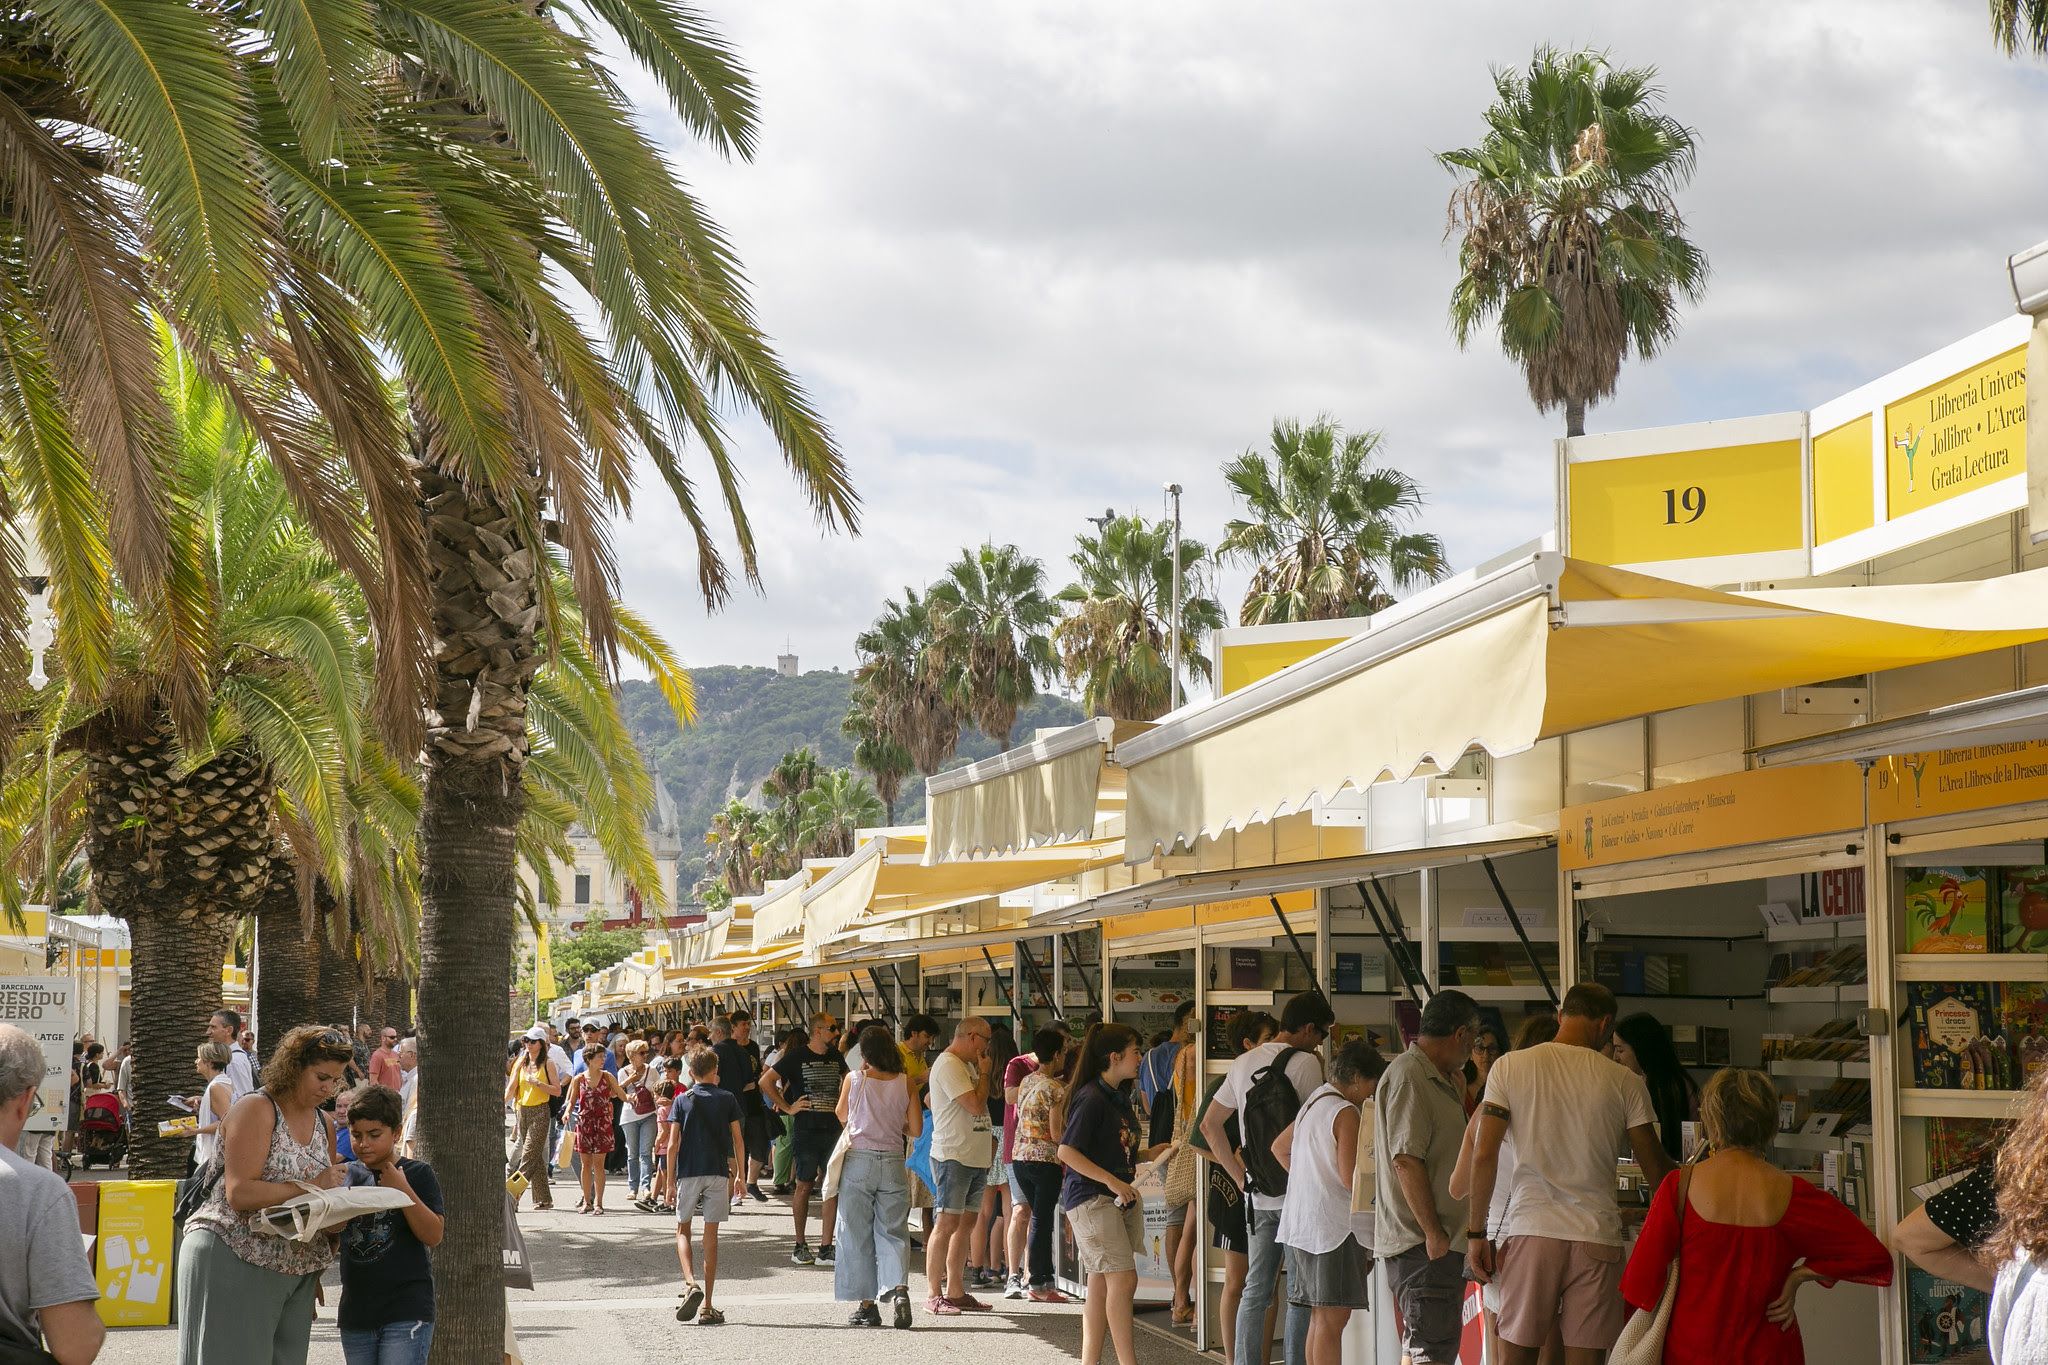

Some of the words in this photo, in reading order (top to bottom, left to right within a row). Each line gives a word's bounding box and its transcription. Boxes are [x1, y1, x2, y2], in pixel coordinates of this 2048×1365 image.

[1930, 384, 1978, 422] Llibreria
[1980, 367, 2026, 401] Univers
[1931, 424, 1972, 458] Jollibre
[1986, 404, 2026, 435] L'Arca
[1932, 463, 1963, 491] Grata
[1964, 448, 2009, 480] Lectura
[1663, 486, 1707, 525] 19
[1879, 770, 1889, 790] 19
[1939, 776, 1963, 792] L'Arca
[1965, 769, 1992, 789] Llibres
[1993, 767, 2003, 784] de
[2004, 764, 2012, 782] la
[1565, 829, 1573, 845] 18
[1800, 871, 1820, 917] LA
[1935, 1009, 1971, 1018] Princeses
[503, 1249, 522, 1265] M
